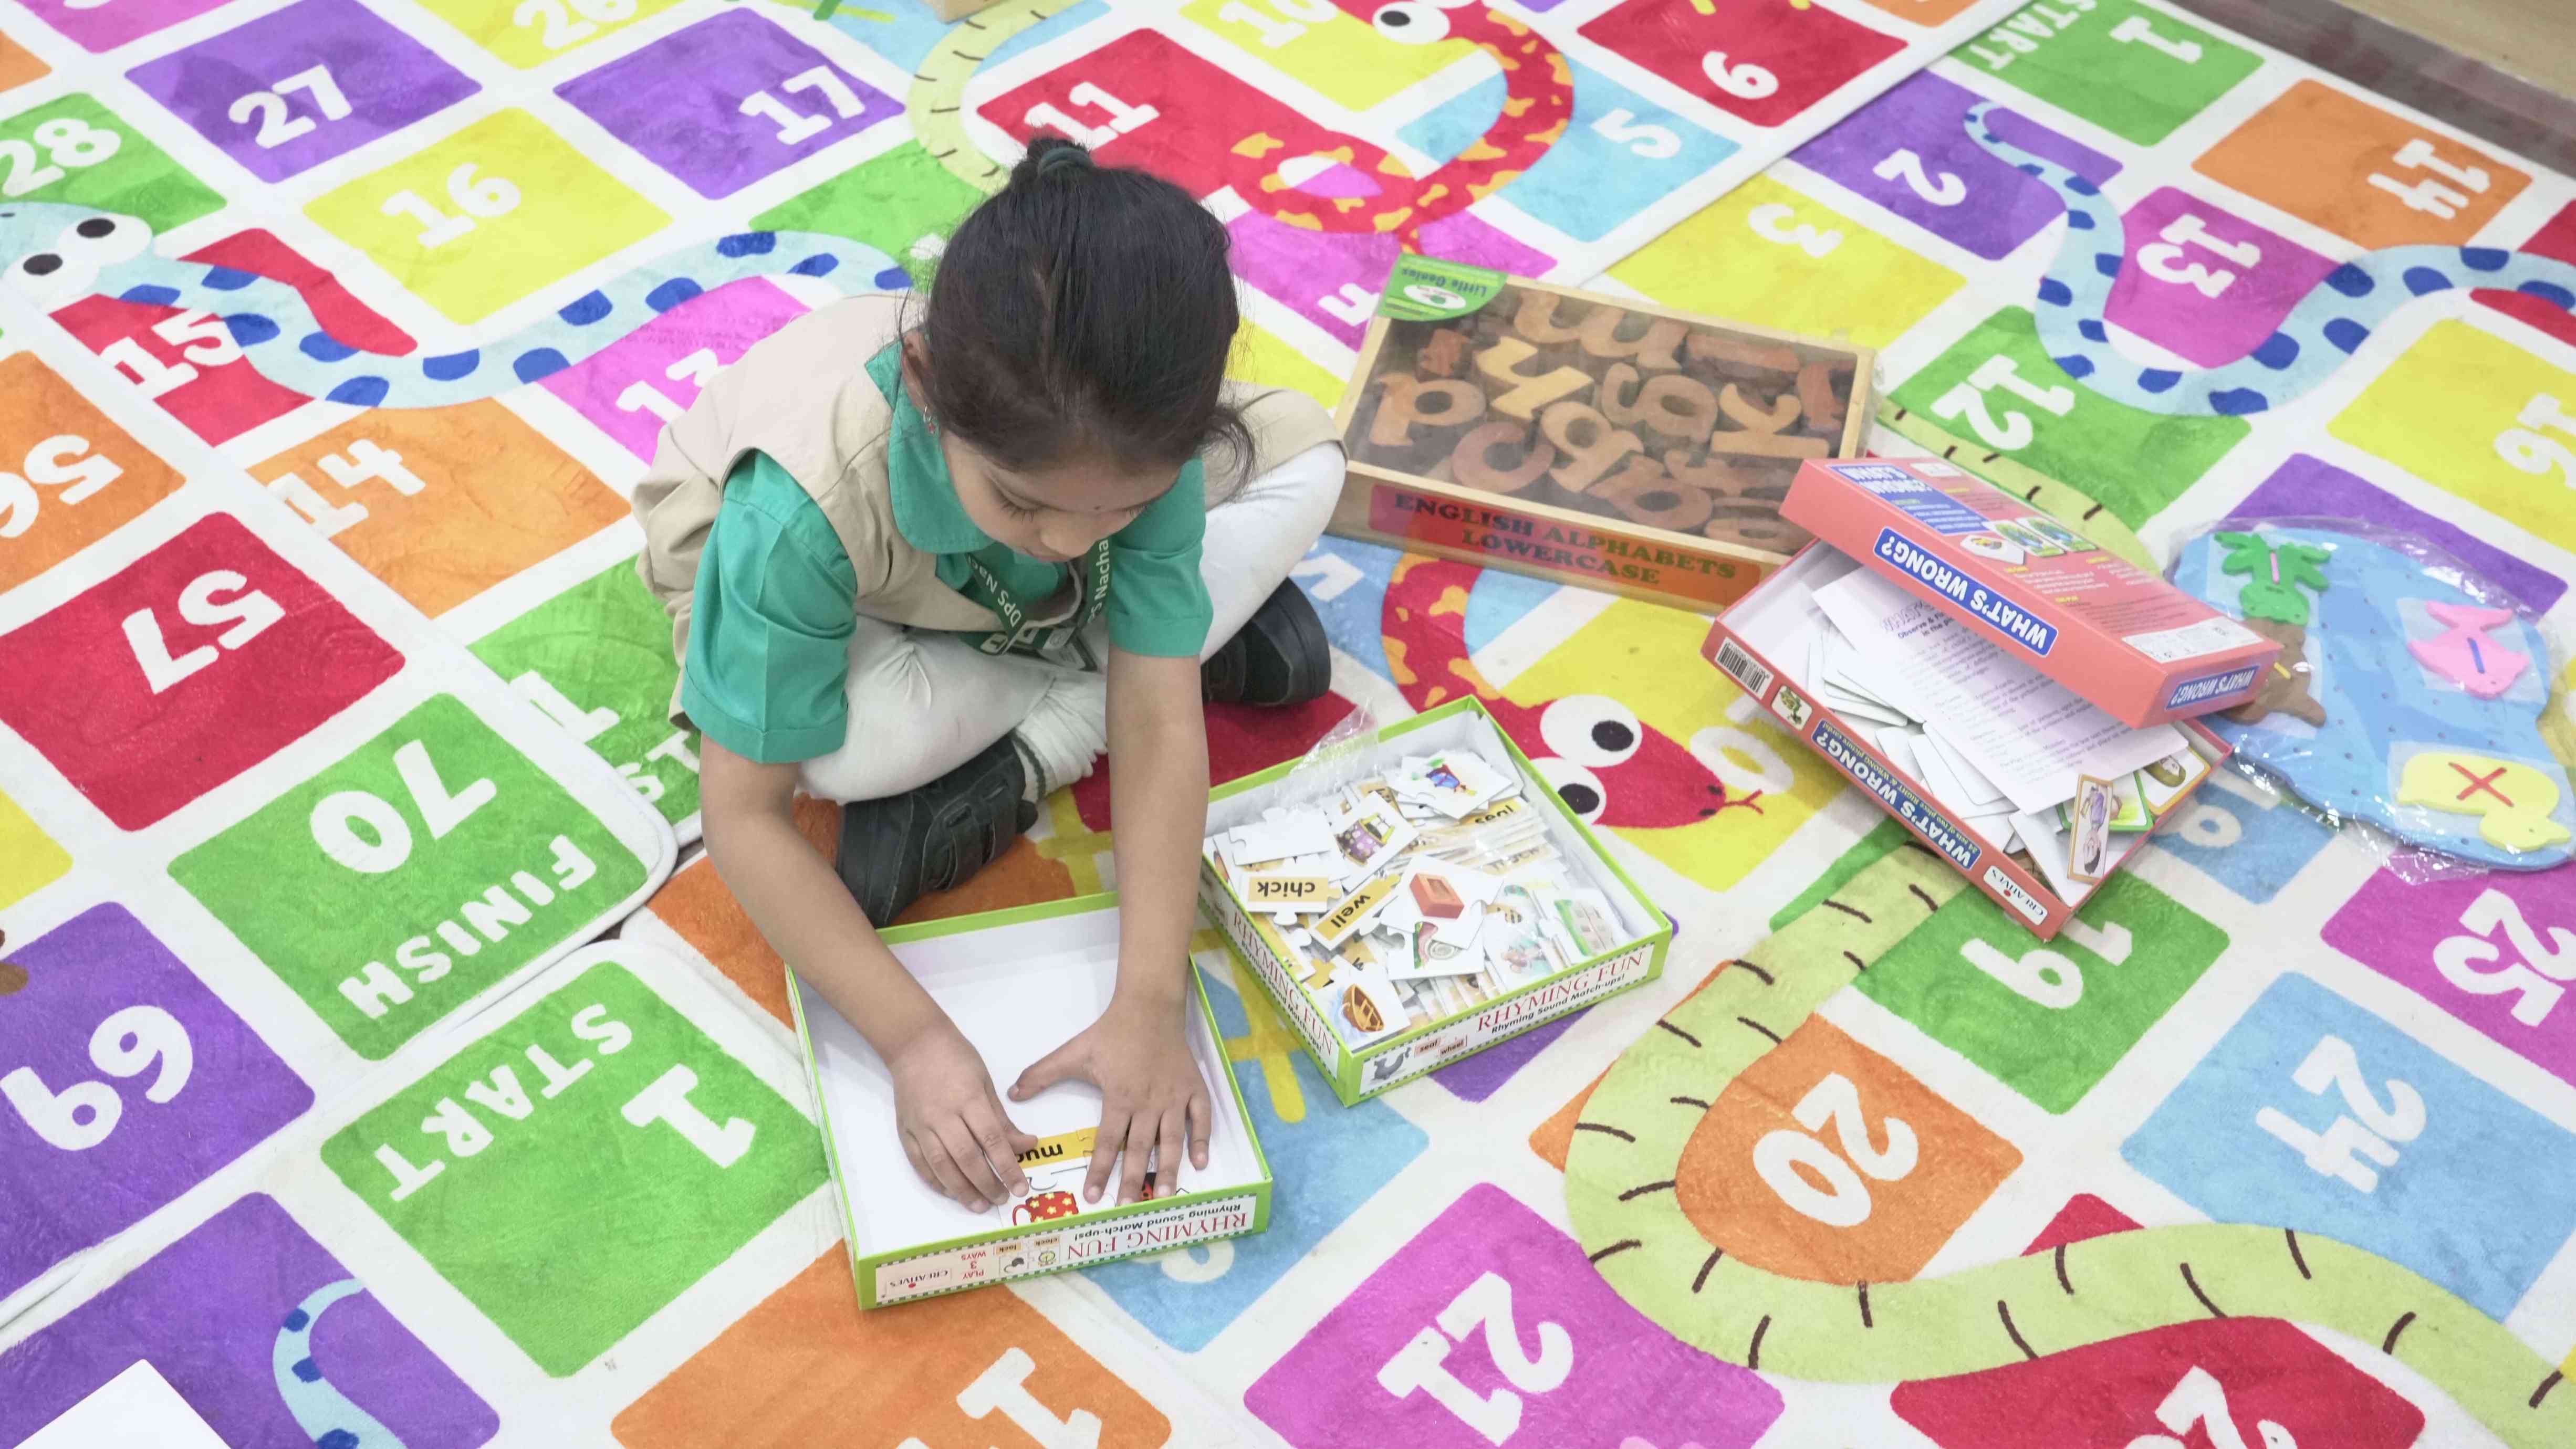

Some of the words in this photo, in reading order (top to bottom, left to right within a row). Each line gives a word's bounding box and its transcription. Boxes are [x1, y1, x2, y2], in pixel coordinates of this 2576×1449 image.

[2109, 16, 2203, 64] 1
[228, 64, 353, 150] 27
[738, 65, 867, 146] 17
[1023, 80, 1161, 151] 11
[1590, 108, 1682, 159] 5
[0, 118, 121, 197] 28
[1873, 148, 1967, 206] 2
[2367, 139, 2490, 219] 14
[382, 162, 522, 249] 16
[1748, 203, 1843, 259] 3
[2136, 213, 2262, 299] 13
[99, 309, 245, 400] 15
[1930, 354, 2076, 451] 12
[267, 438, 426, 538] 14
[1394, 493, 1534, 537] ENGLISH
[1542, 527, 1737, 579] ALPHABETS
[1462, 528, 1661, 584] LOWERCASE
[1881, 536, 1968, 601] WRONG?
[121, 569, 286, 695] 57
[997, 589, 1022, 627] DPS
[1970, 589, 2048, 649] WHAT'S
[2171, 679, 2218, 706] WRONG?
[1816, 732, 1897, 806] WRONG?
[1842, 738, 1865, 758] picture
[1864, 755, 1890, 781] WRONG
[309, 738, 497, 874] 70
[1898, 784, 1920, 805] RIGHT
[1900, 801, 1973, 867] WHAT'S
[1257, 880, 1316, 898] chick
[1330, 895, 1371, 929] well
[337, 834, 598, 1019] FINISH
[2433, 888, 2576, 1028] 25
[1477, 972, 1589, 1033] RHYMING
[1597, 952, 1644, 982] FUN
[1492, 1012, 1535, 1035] Rhyming
[1538, 998, 1569, 1016] Sound
[1570, 973, 1626, 1002] Match-ups!
[1419, 1038, 1440, 1052] seal
[1441, 1041, 1465, 1056] wheel
[0, 1005, 193, 1151] 69
[374, 1003, 632, 1202] START
[620, 1063, 757, 1170] 1
[2256, 1035, 2427, 1194] 24
[1753, 1072, 1920, 1228] 20
[1074, 1219, 1144, 1242] Match-ups!
[1127, 1212, 1247, 1254] RHYMING
[1148, 1212, 1184, 1227] Sound
[1187, 1203, 1242, 1219] Rhyming
[961, 1251, 986, 1261] WAYS
[963, 1270, 985, 1280] PLAY
[970, 1261, 977, 1269] 3
[1068, 1234, 1118, 1261] FUN
[1376, 1270, 1574, 1447] 21
